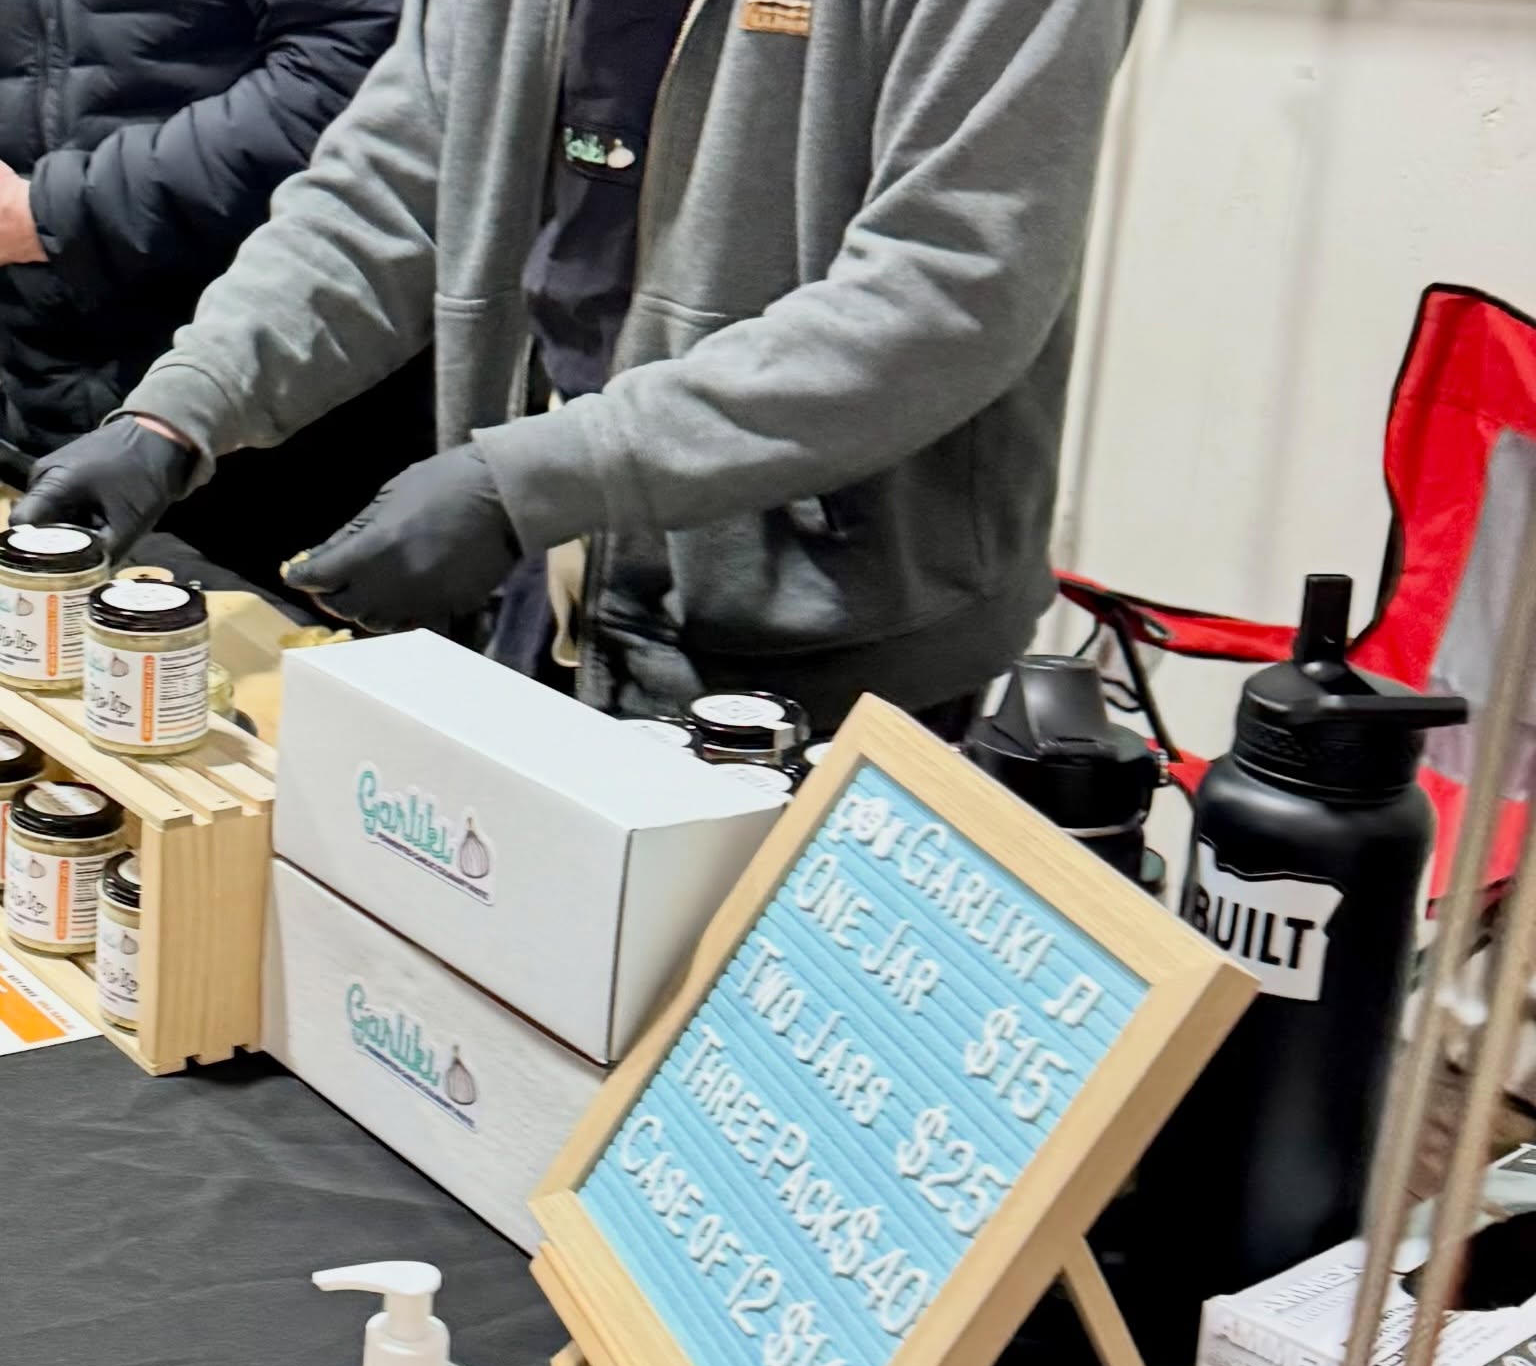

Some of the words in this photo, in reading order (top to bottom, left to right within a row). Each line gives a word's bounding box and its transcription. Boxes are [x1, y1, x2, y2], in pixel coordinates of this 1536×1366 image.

[357, 770, 455, 865] Garliki
[892, 821, 1056, 979] GARLIKI
[795, 852, 876, 951] ONE
[855, 920, 943, 1017] JAR
[964, 1002, 1074, 1123] $15
[1180, 883, 1316, 970] BUILT
[346, 982, 441, 1087] Garliki
[735, 936, 795, 1036] TWO
[793, 1013, 894, 1130] JARS
[896, 1105, 1012, 1236] $25
[617, 1113, 706, 1238] CASE
[684, 1213, 742, 1287] OF
[729, 1249, 783, 1341] 12
[676, 1024, 771, 1159] THREE
[756, 1122, 853, 1251] PACK
[830, 1199, 932, 1341] $40
